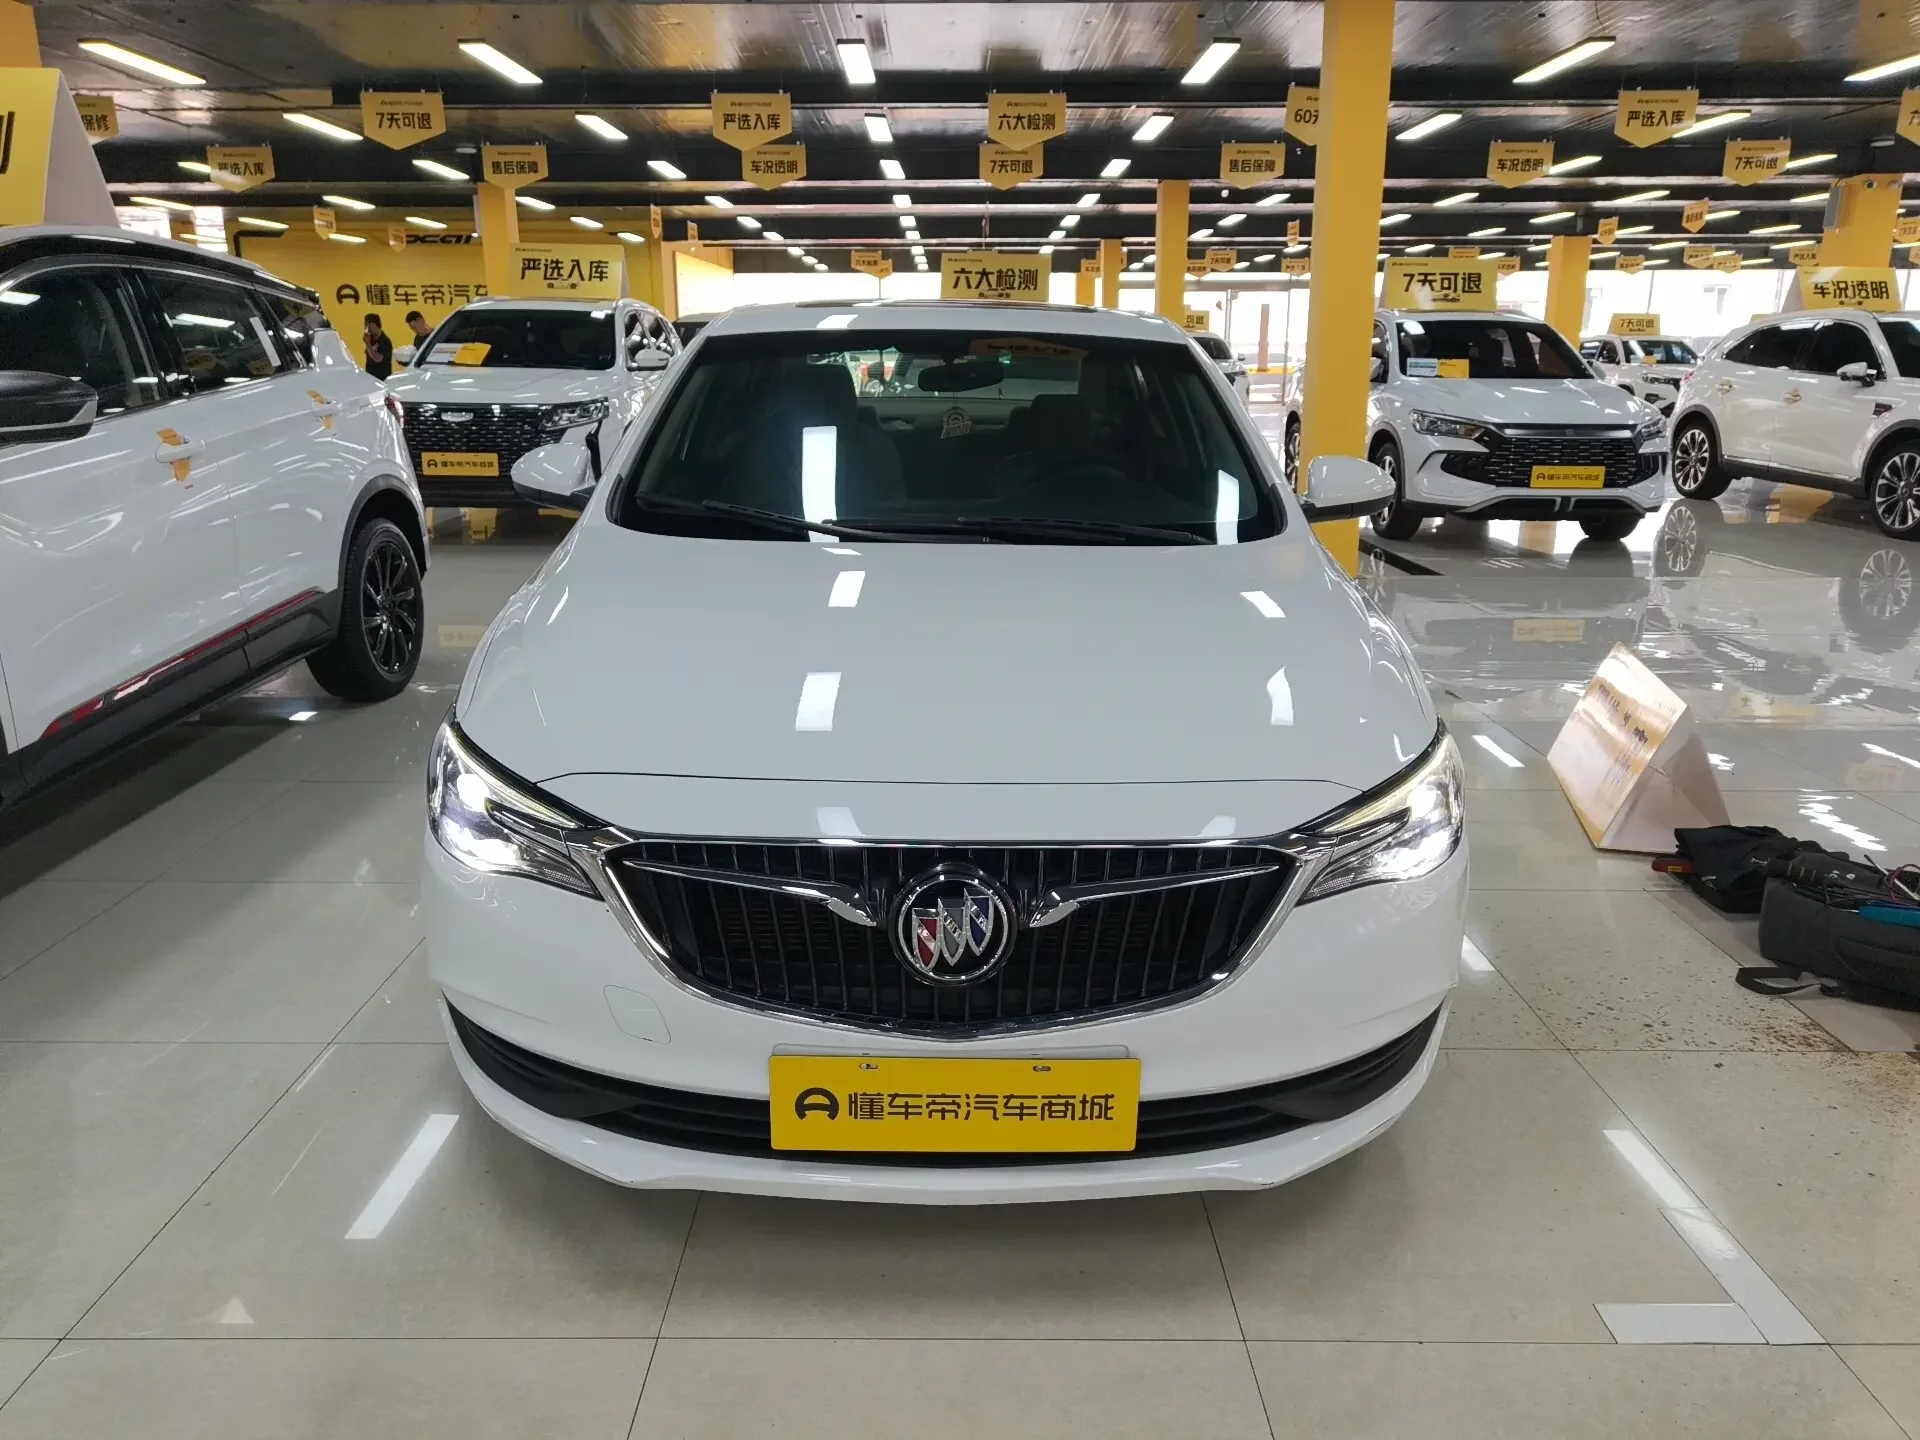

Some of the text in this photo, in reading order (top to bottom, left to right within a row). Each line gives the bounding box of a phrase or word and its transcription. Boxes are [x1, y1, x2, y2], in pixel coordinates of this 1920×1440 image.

[376, 112, 432, 129] 7天可退
[723, 113, 781, 130] 严选入库
[998, 113, 1056, 130] 六大检测
[1626, 110, 1686, 127] 严选入库
[218, 162, 265, 176] 严选入库
[491, 160, 538, 174] 售后保障
[751, 160, 798, 174] 车况透明
[990, 160, 1034, 174] 7天可退
[1229, 159, 1276, 173] 售后保障
[1496, 158, 1545, 171] 车况透明
[1734, 156, 1780, 170] 7天可退
[521, 258, 609, 282] 严选入库
[952, 268, 1039, 291] 六大检测
[1403, 273, 1482, 293] 7天可退
[1813, 280, 1890, 299] 车况透明
[848, 1092, 1115, 1121] 懂车帝汽车商城
